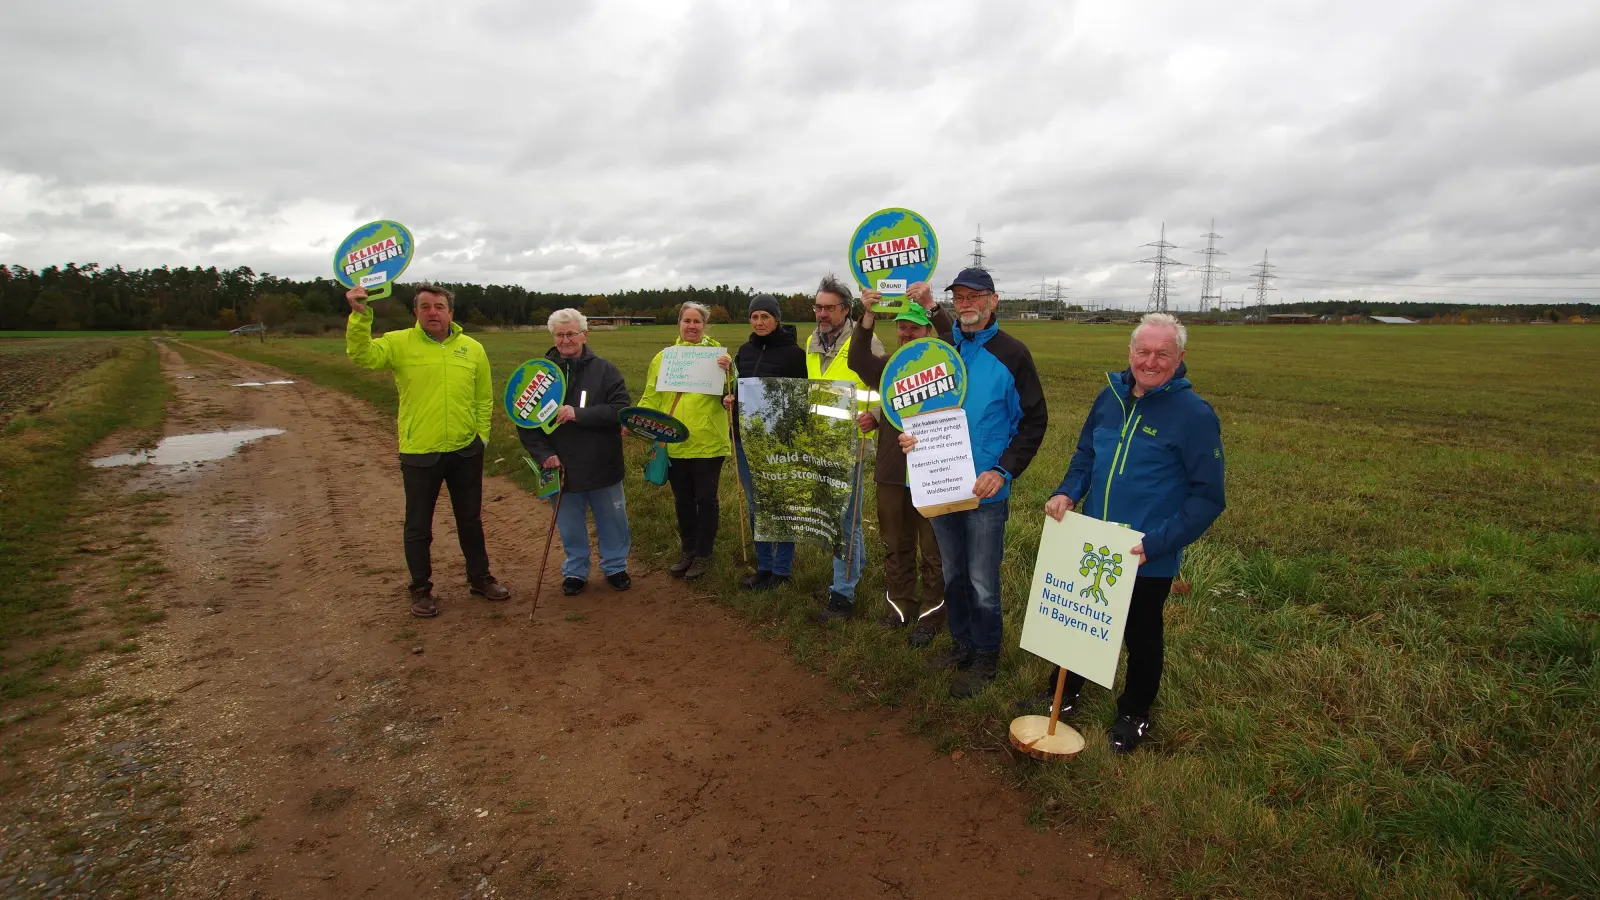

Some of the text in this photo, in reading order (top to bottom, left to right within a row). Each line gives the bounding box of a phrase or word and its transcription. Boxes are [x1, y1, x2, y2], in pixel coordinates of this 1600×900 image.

[349, 239, 395, 262] KLIMA
[868, 237, 918, 257] KLIMA
[345, 245, 403, 275] RETTEN!
[861, 249, 926, 272] RETTEN!
[896, 366, 945, 394] KLIMA
[516, 373, 545, 409] KLIMA
[520, 373, 555, 419] RETTEN!
[892, 376, 955, 411] RETTEN!
[911, 428, 929, 436] Wälder
[930, 426, 943, 434] nicht
[922, 419, 938, 427] haben
[766, 451, 841, 469] Wald erhalten
[912, 454, 968, 468] Federstrich vernichtet
[929, 465, 951, 473] werden!
[761, 471, 788, 480] trotz
[932, 476, 963, 486] betroffenen
[926, 485, 961, 495] Waldbesitzer
[1045, 572, 1074, 593] Bund
[1042, 587, 1112, 625] Naturschutz
[1039, 602, 1109, 641] in Bayern e.V.
